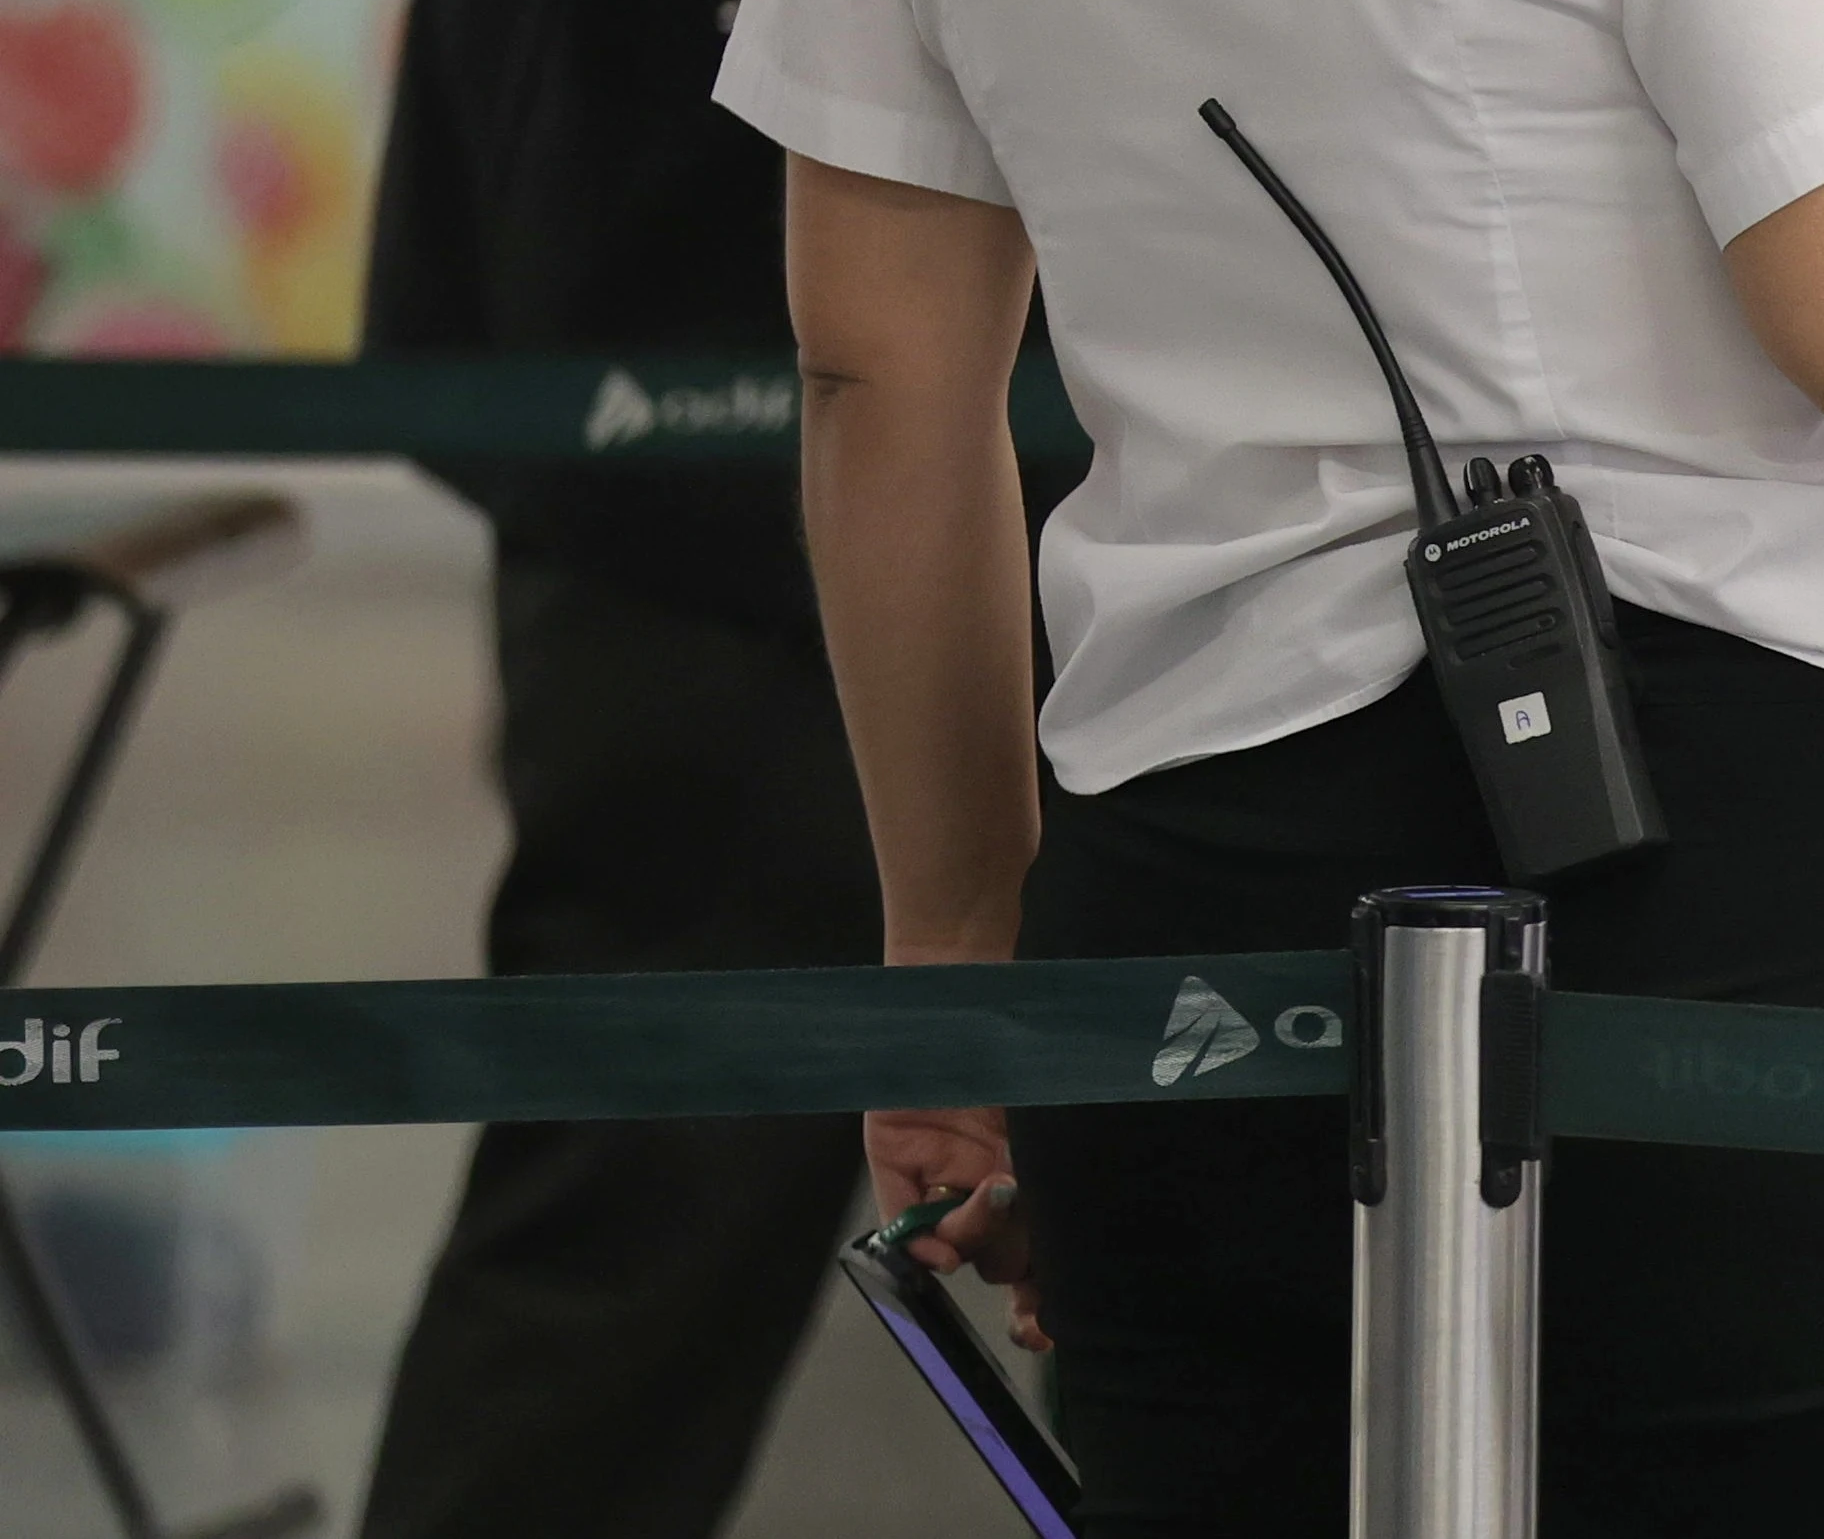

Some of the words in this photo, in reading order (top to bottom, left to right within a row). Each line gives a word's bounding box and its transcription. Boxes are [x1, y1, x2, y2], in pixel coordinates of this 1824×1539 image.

[1446, 517, 1531, 552] MOTOROLA
[1515, 710, 1531, 731] A
[0, 1017, 122, 1086] dif
